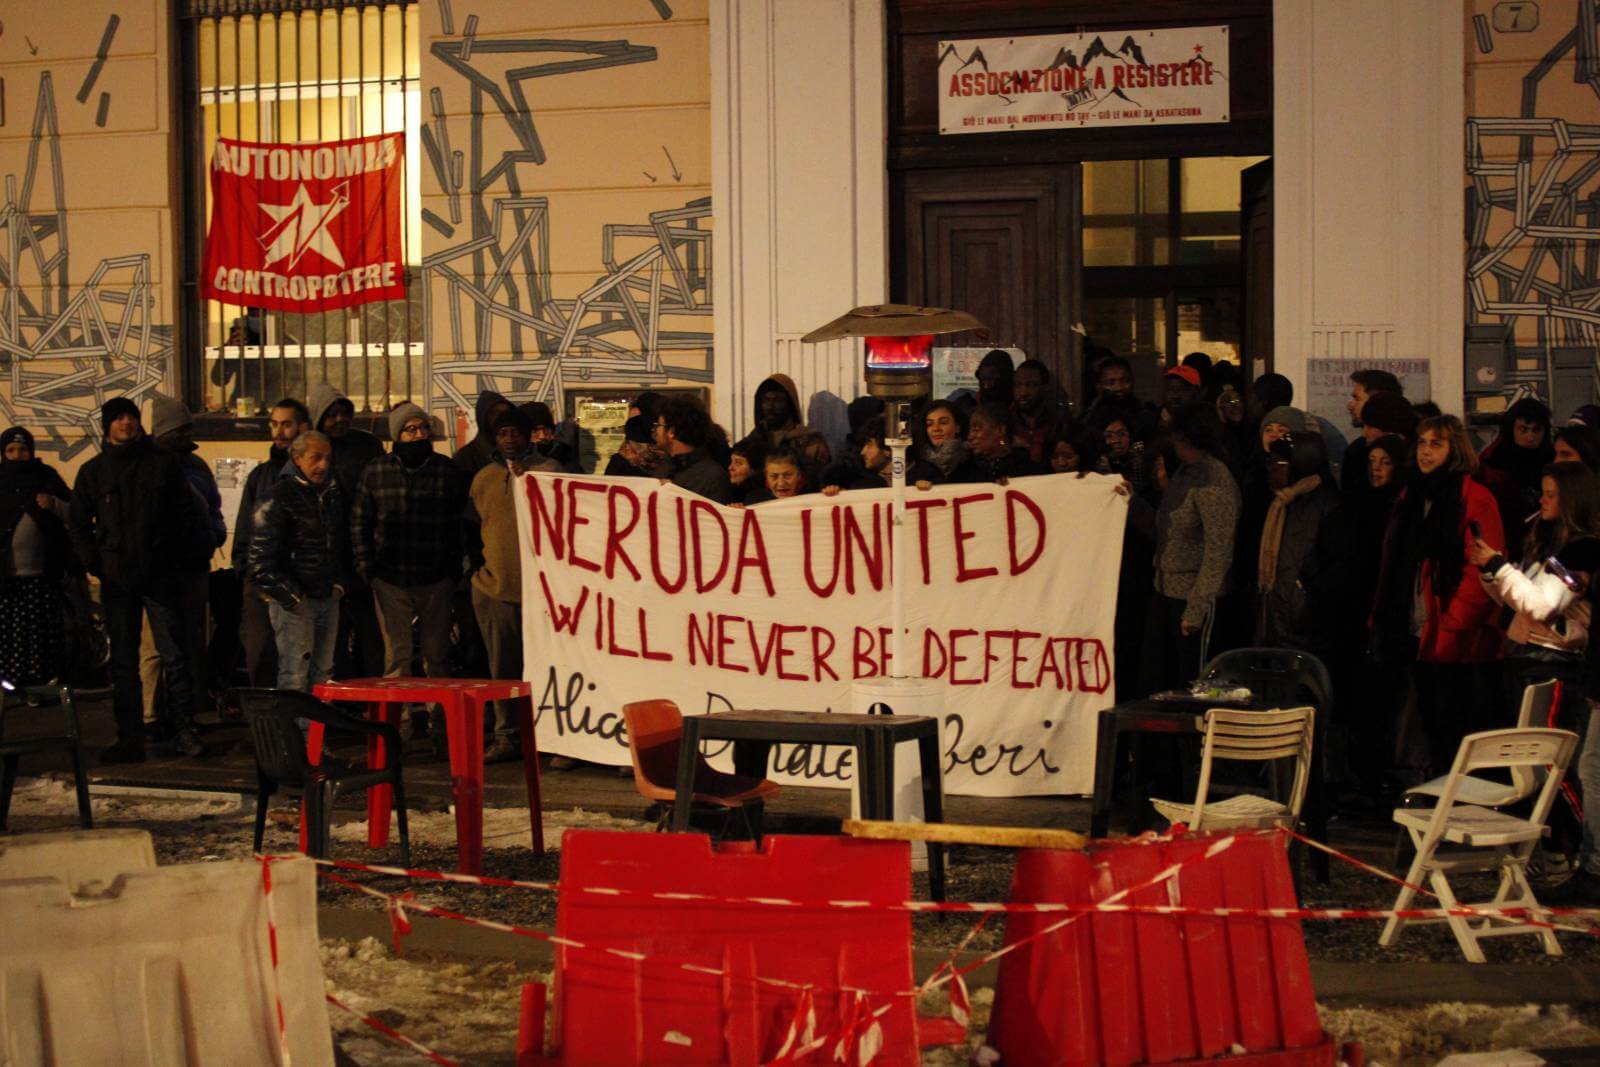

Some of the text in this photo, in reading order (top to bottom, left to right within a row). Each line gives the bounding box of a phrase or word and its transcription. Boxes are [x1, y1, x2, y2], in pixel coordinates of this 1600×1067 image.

[1509, 6, 1523, 28] 7
[949, 67, 1087, 97] ASSOCIAZIONE
[1093, 65, 1107, 90] A
[1113, 61, 1214, 89] RESISTERE
[213, 137, 397, 181] AUTONOMIA
[213, 261, 397, 301] CONTROPOTERE
[526, 474, 776, 598] NERUDA
[539, 571, 673, 661] WILL
[687, 611, 840, 682] NEVER
[921, 626, 1112, 694] DEFEATED
[534, 665, 631, 748] Alice
